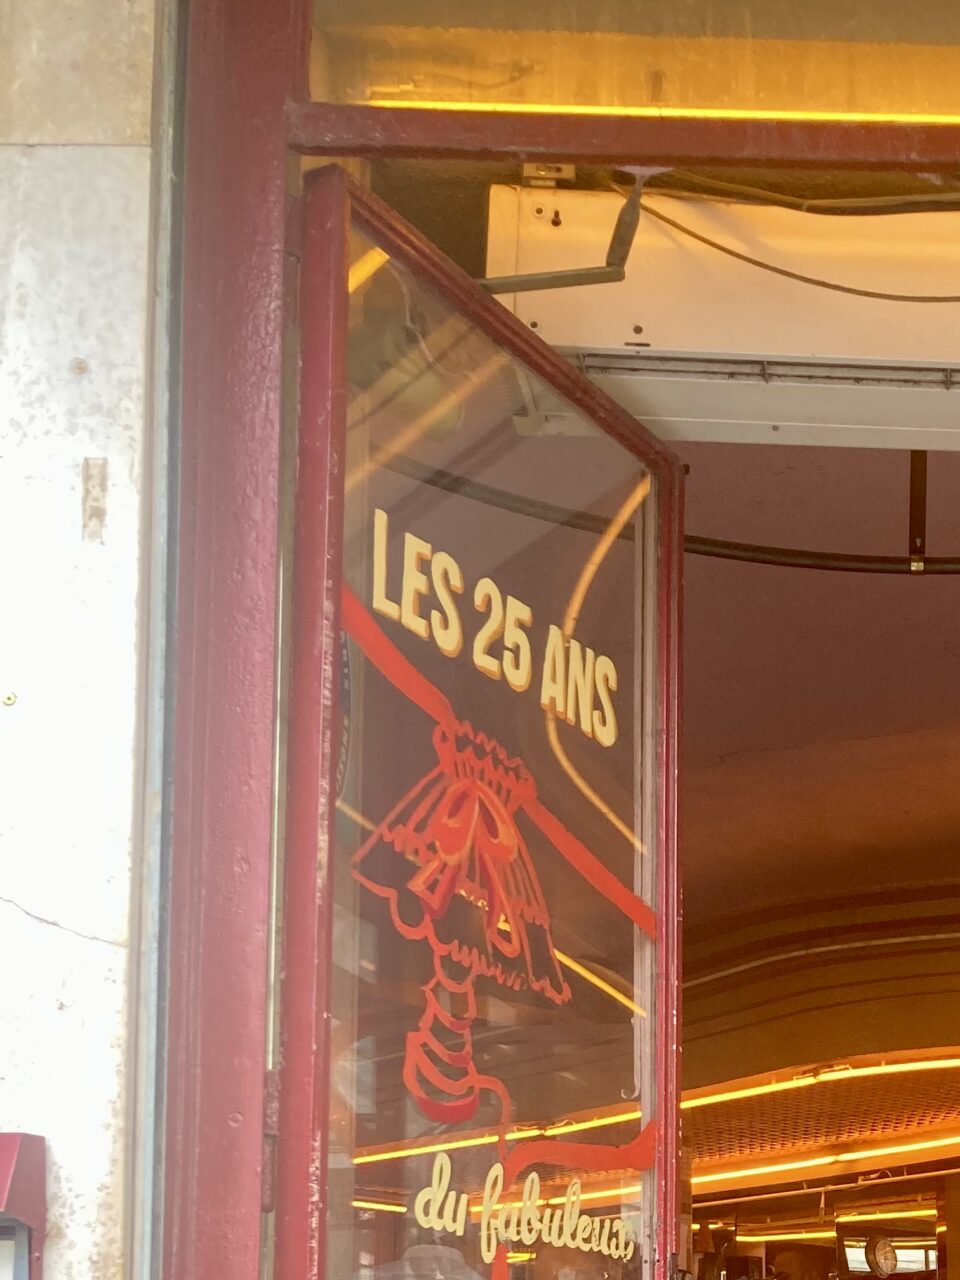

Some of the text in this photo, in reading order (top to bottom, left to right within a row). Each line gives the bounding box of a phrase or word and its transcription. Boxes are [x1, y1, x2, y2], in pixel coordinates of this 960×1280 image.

[372, 508, 618, 748] LES 25 ANS
[414, 1151, 635, 1264] du fabuleux
